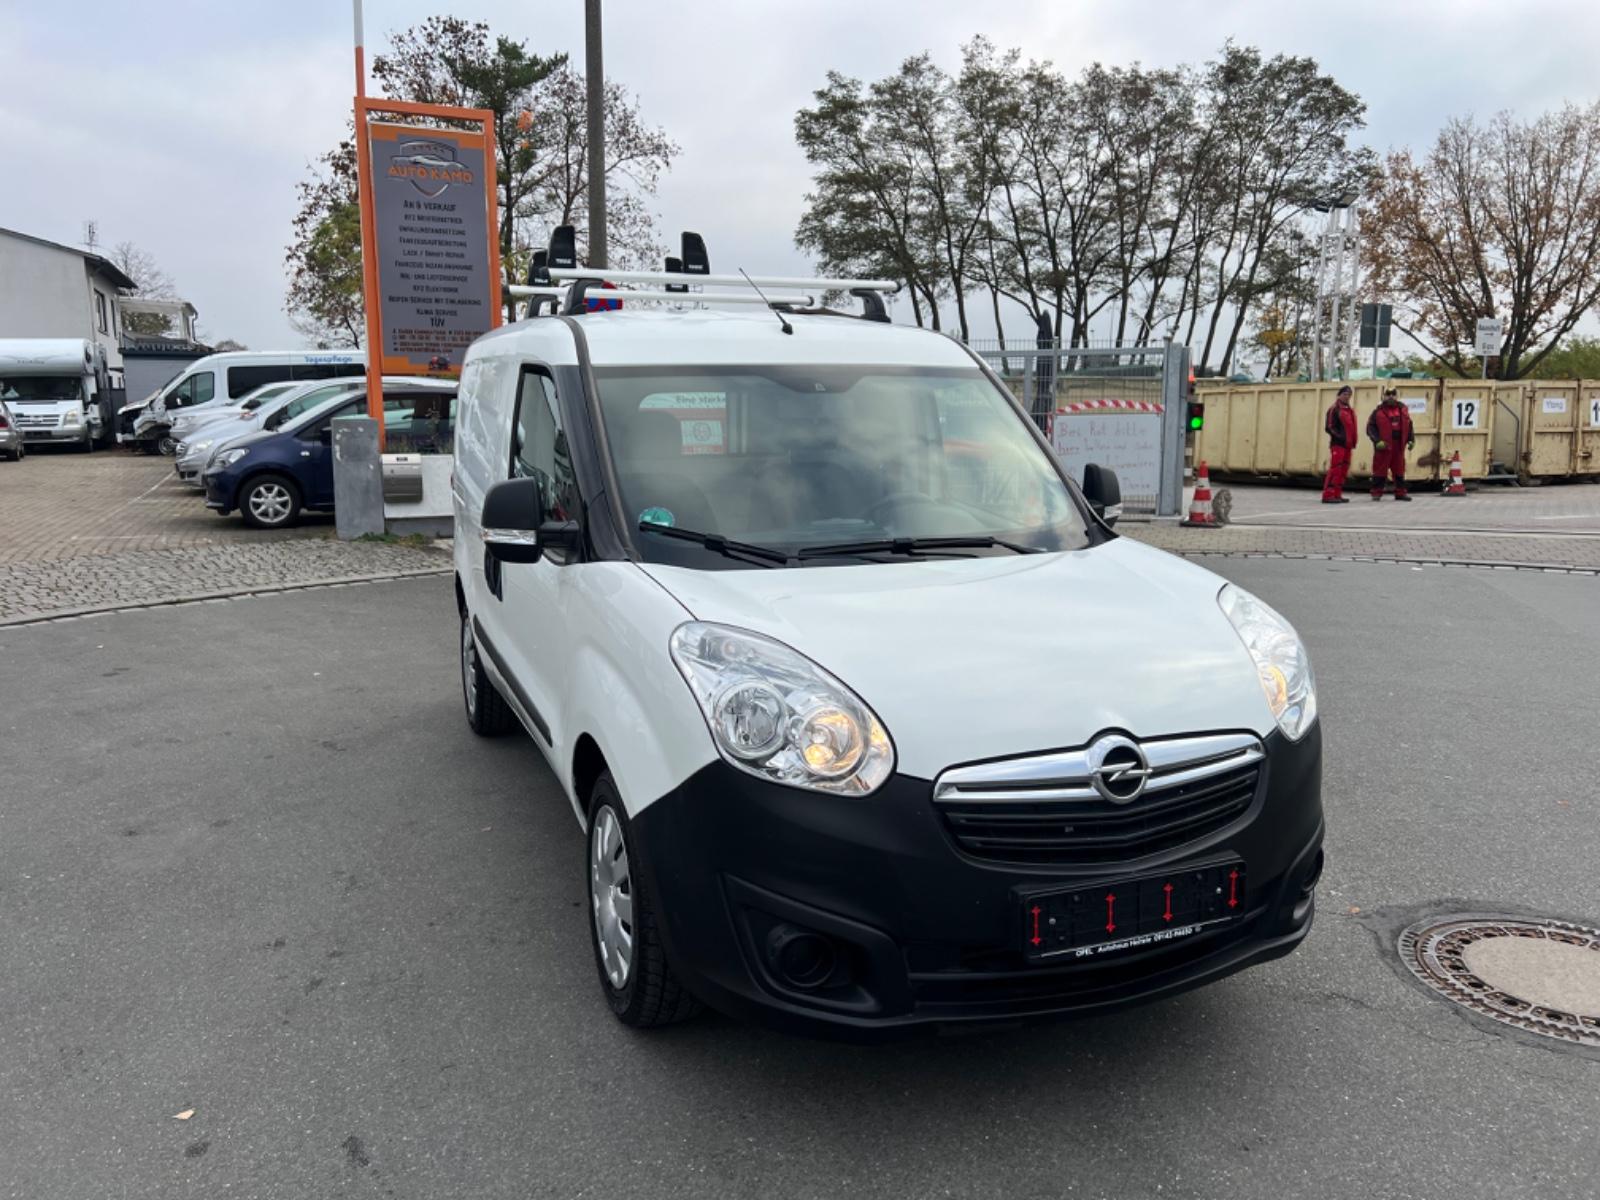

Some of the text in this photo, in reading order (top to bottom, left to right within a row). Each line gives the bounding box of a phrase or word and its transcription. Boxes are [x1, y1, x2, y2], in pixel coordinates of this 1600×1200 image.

[388, 165, 428, 178] AUTO
[424, 202, 456, 212] VERKAUF
[430, 317, 445, 327] TÜV
[1456, 402, 1475, 425] 12
